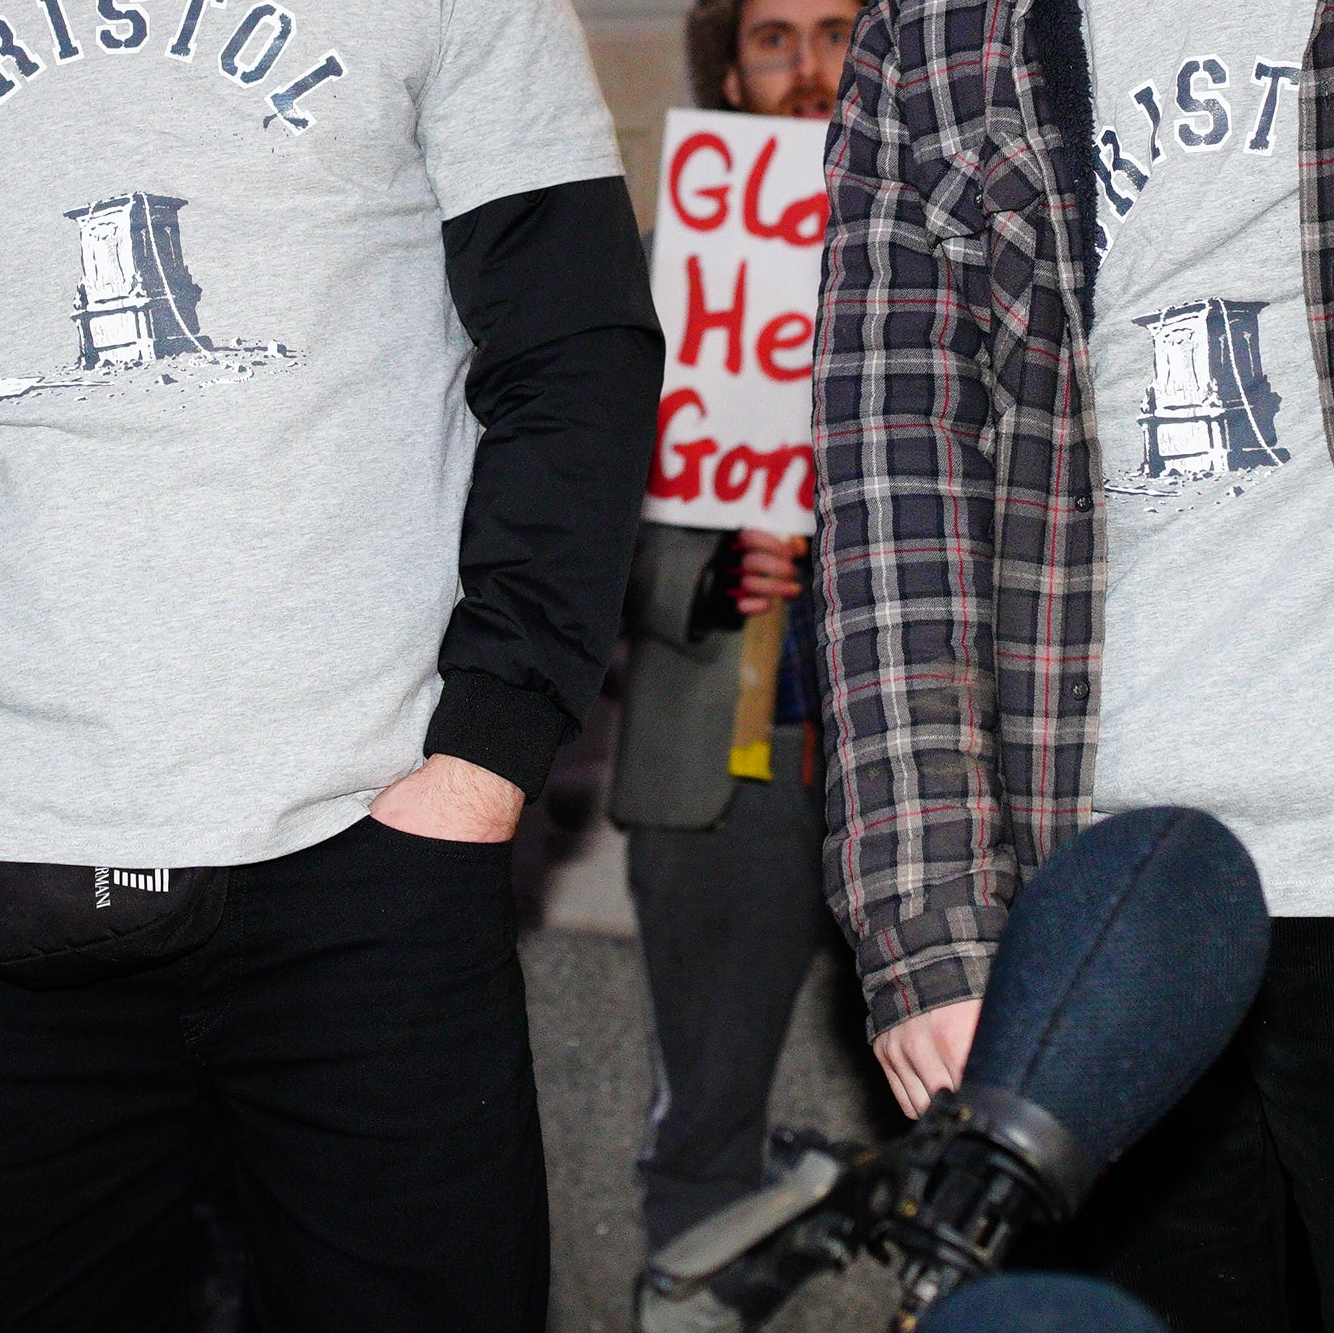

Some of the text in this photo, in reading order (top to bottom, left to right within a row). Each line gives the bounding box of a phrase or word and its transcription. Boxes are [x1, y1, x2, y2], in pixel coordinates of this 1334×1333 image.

[1092, 54, 1302, 269] RIST
[677, 254, 814, 383] He
[645, 387, 815, 512] Gon
